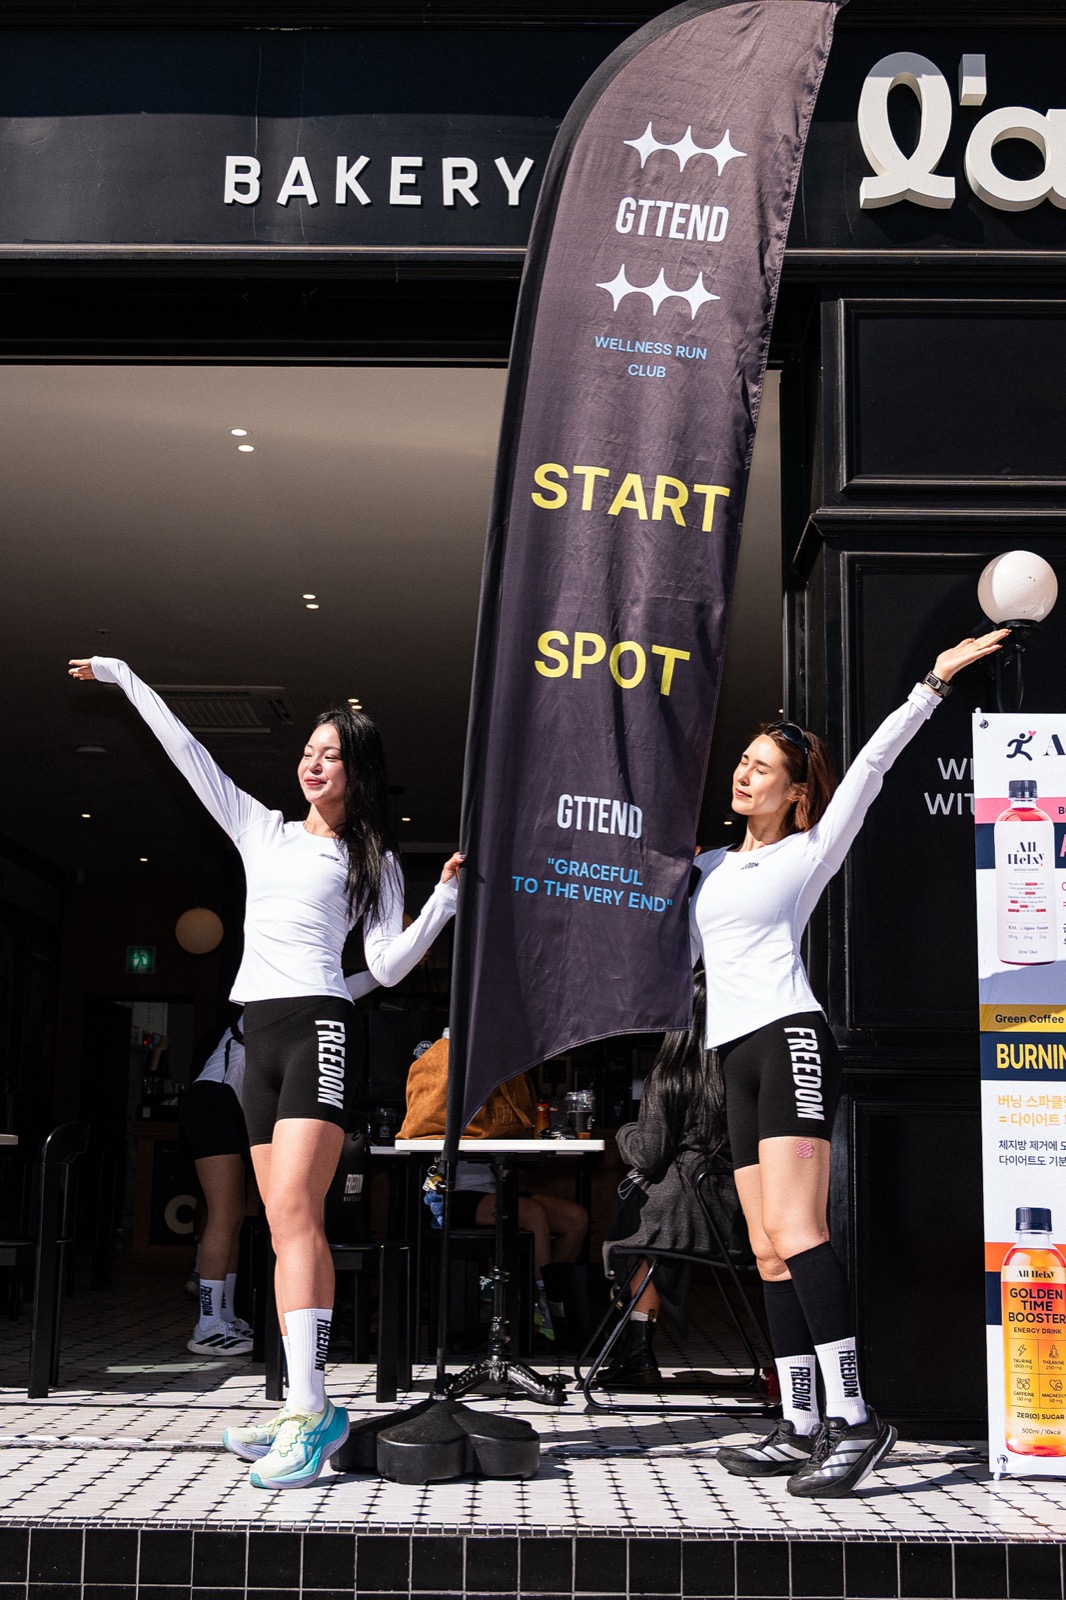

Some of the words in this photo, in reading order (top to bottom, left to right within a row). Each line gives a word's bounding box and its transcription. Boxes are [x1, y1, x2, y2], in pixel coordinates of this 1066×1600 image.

[224, 156, 535, 206] BAKERY
[615, 197, 729, 243] GTTEND
[595, 335, 672, 357] WELLNESS
[675, 344, 707, 361] RUN
[627, 363, 666, 378] CLUB
[531, 463, 731, 533] START
[534, 630, 691, 696] SPOT
[556, 793, 643, 839] GTTEND
[1017, 841, 1036, 852] All
[1008, 853, 1044, 866] Helxy
[547, 857, 643, 886] "GRACEFUL
[512, 875, 539, 894] TO
[543, 879, 579, 899] THE
[583, 885, 625, 906] VERY
[628, 892, 673, 913] END"
[995, 1014, 1026, 1023] Green
[1029, 1014, 1065, 1023] Coffee
[315, 1020, 346, 1109] FREEDOM
[783, 1027, 825, 1121] FREEDOM
[997, 1095, 1022, 1108] 버닝
[1025, 1095, 1066, 1109] 스파클
[1011, 1113, 1060, 1127] 다이어트
[999, 1140, 1027, 1151] 체지방
[1029, 1140, 1058, 1151] 제거에
[999, 1155, 1046, 1166] 다이어트도
[1017, 1270, 1029, 1278] All
[1010, 1288, 1063, 1299] GOLDEN
[1021, 1300, 1053, 1311] TIME
[1009, 1312, 1066, 1324] BOOSTER
[315, 1318, 331, 1371] FREEDOM
[838, 1350, 859, 1398] FREEDOM
[789, 1366, 811, 1412] FREEDOM
[1016, 1411, 1040, 1420] ZER(O)
